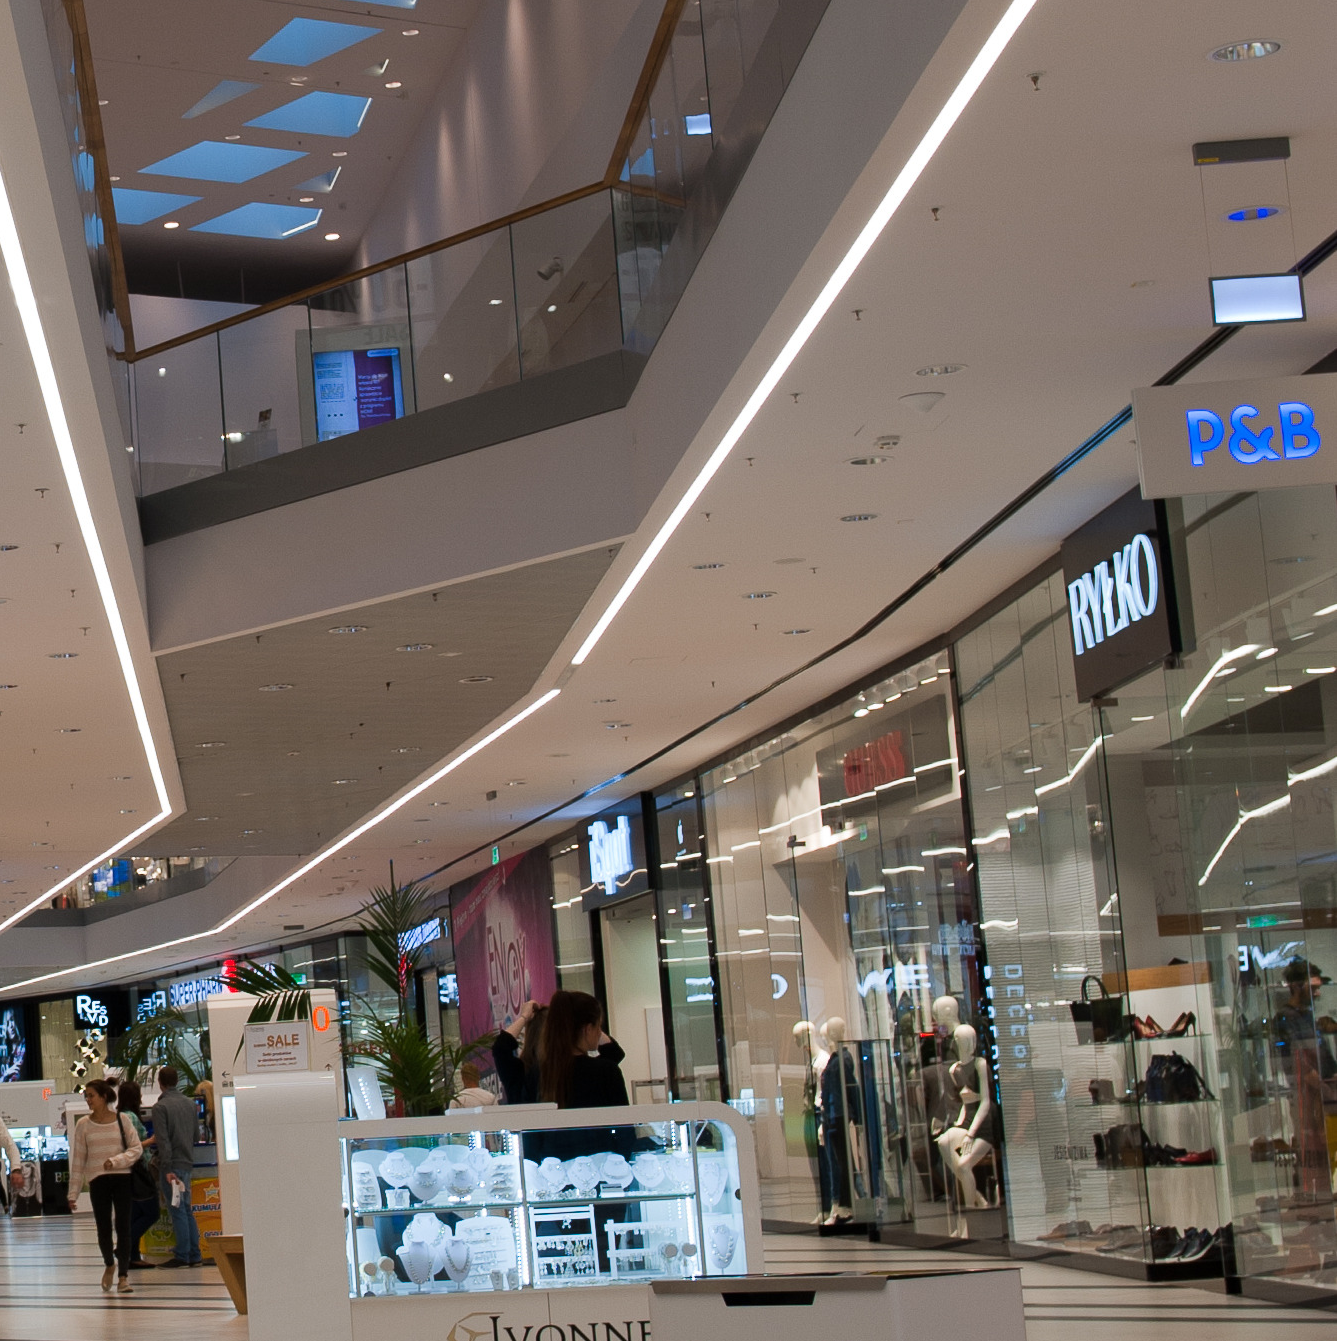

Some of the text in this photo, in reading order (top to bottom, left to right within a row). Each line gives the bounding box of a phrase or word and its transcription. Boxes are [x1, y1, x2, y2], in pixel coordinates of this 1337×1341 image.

[1185, 401, 1321, 467] P&B
[1068, 533, 1158, 656] RYŁKO
[587, 815, 634, 896] iSpot
[267, 1033, 300, 1048] SALE
